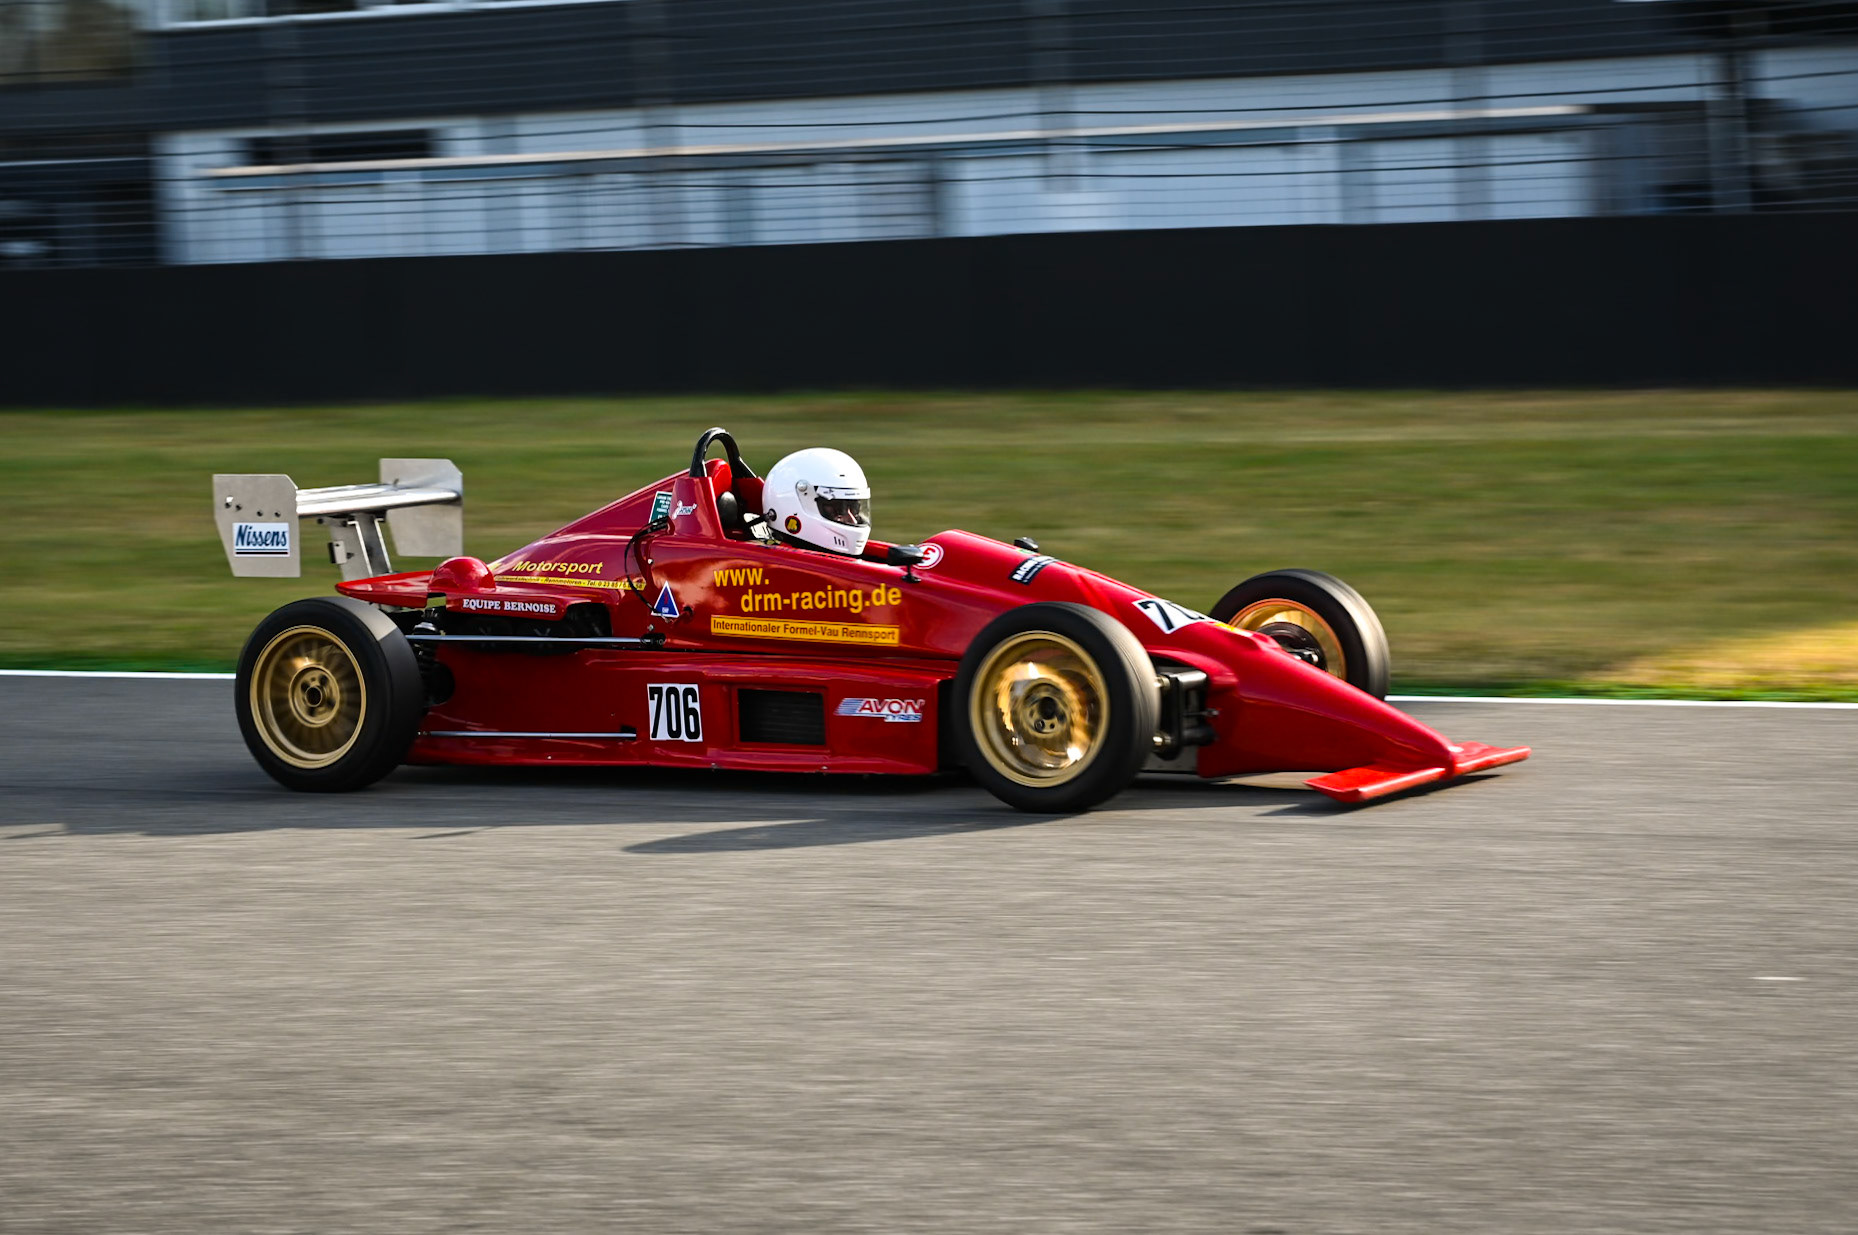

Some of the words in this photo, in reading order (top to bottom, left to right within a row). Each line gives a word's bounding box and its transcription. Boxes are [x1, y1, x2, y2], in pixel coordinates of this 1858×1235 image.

[235, 524, 289, 548] Nissens
[511, 560, 604, 575] Motorsport
[713, 567, 770, 587] www.
[463, 599, 501, 610] EQUIPE
[504, 600, 556, 614] BERNOISE
[740, 583, 902, 614] drm-racing.de
[713, 619, 780, 634] Internationaler
[783, 624, 839, 637] Formel-Vau
[841, 627, 896, 641] Rennsport
[649, 686, 700, 739] 706
[859, 699, 922, 714] AVON
